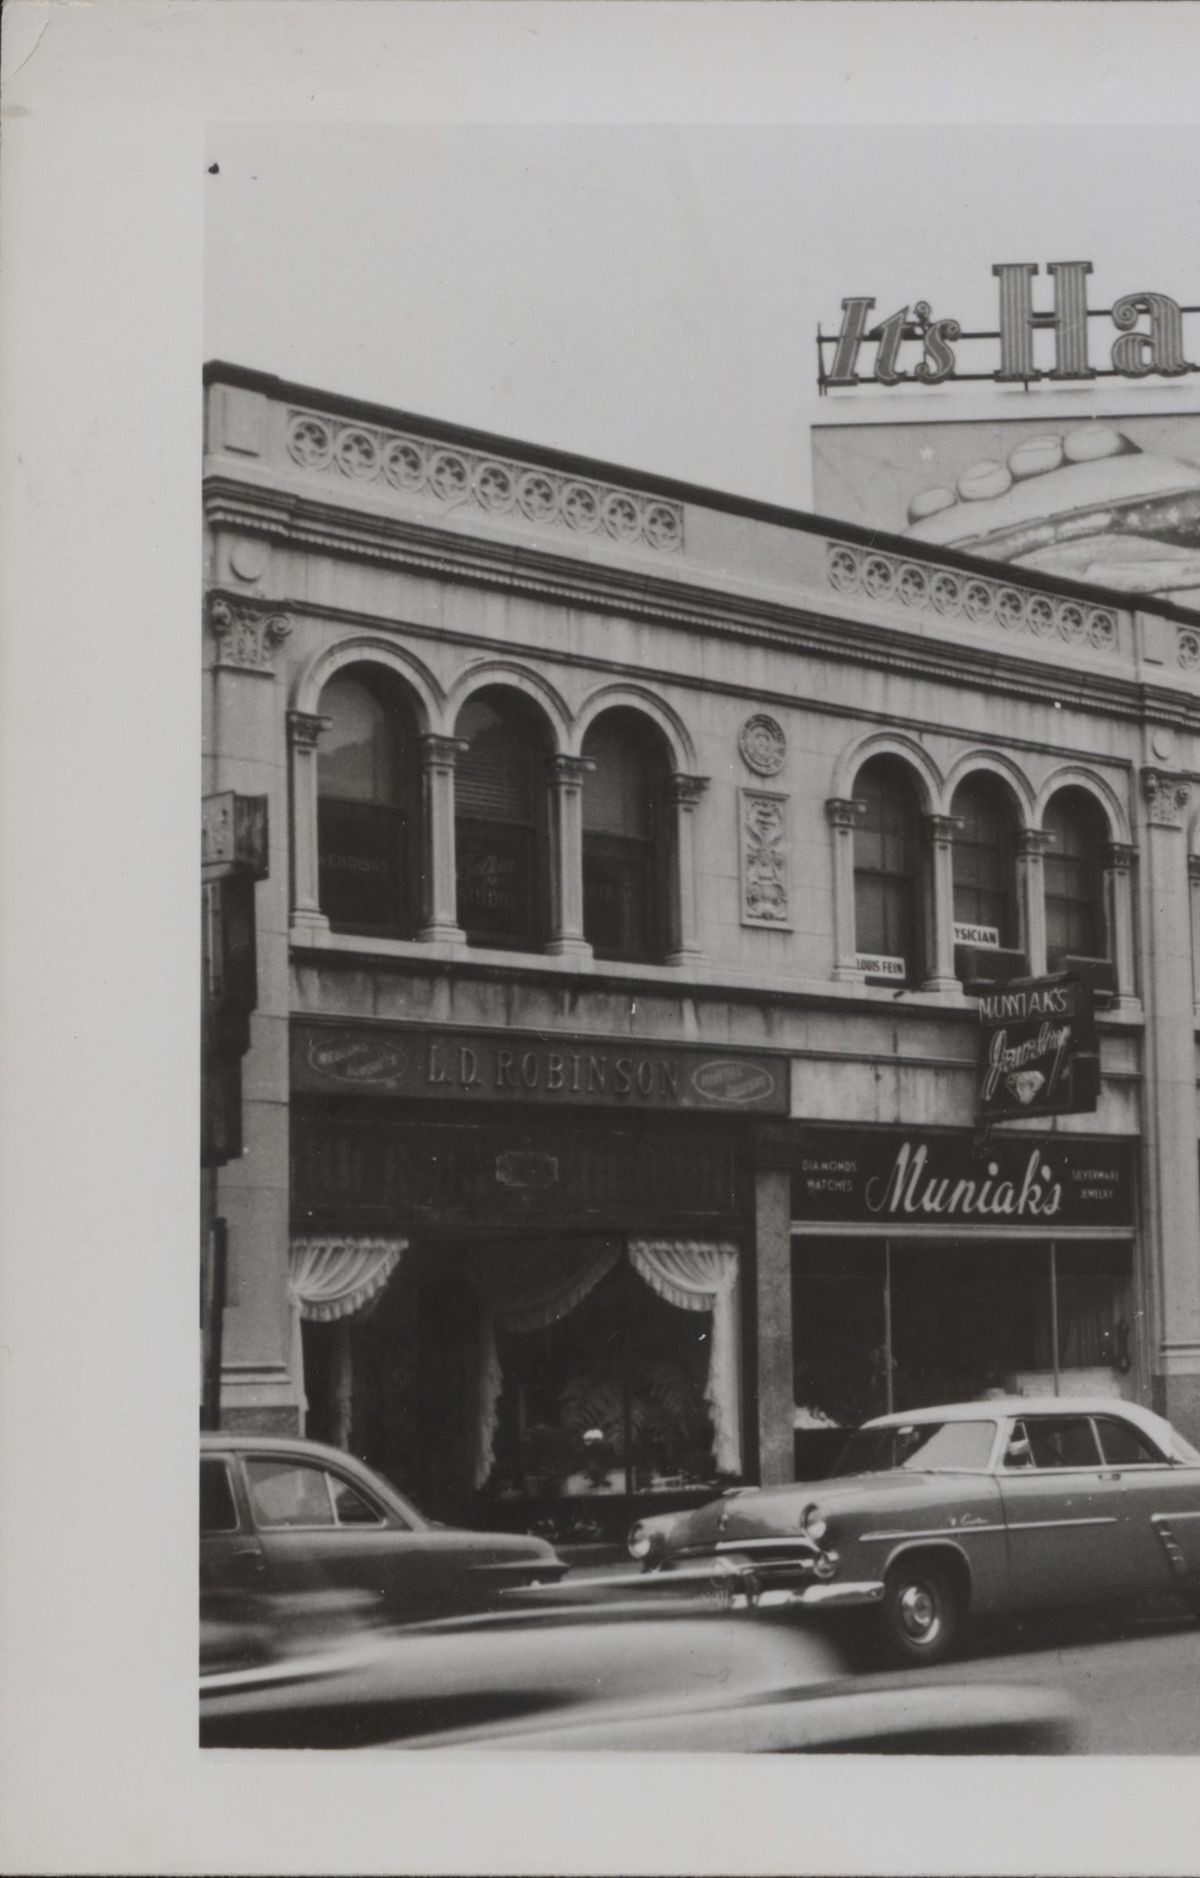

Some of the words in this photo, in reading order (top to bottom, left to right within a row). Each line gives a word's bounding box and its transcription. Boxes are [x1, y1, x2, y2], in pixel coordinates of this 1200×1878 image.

[826, 297, 962, 387] It's
[954, 927, 997, 945] YSICIAN
[856, 957, 880, 972] LOUIS
[882, 960, 904, 976] FEIN
[497, 1051, 681, 1099] ROBINSON
[802, 1159, 858, 1173] DIAMONDS
[806, 1179, 853, 1192] WATCHES
[865, 1142, 1062, 1216] Muniak's
